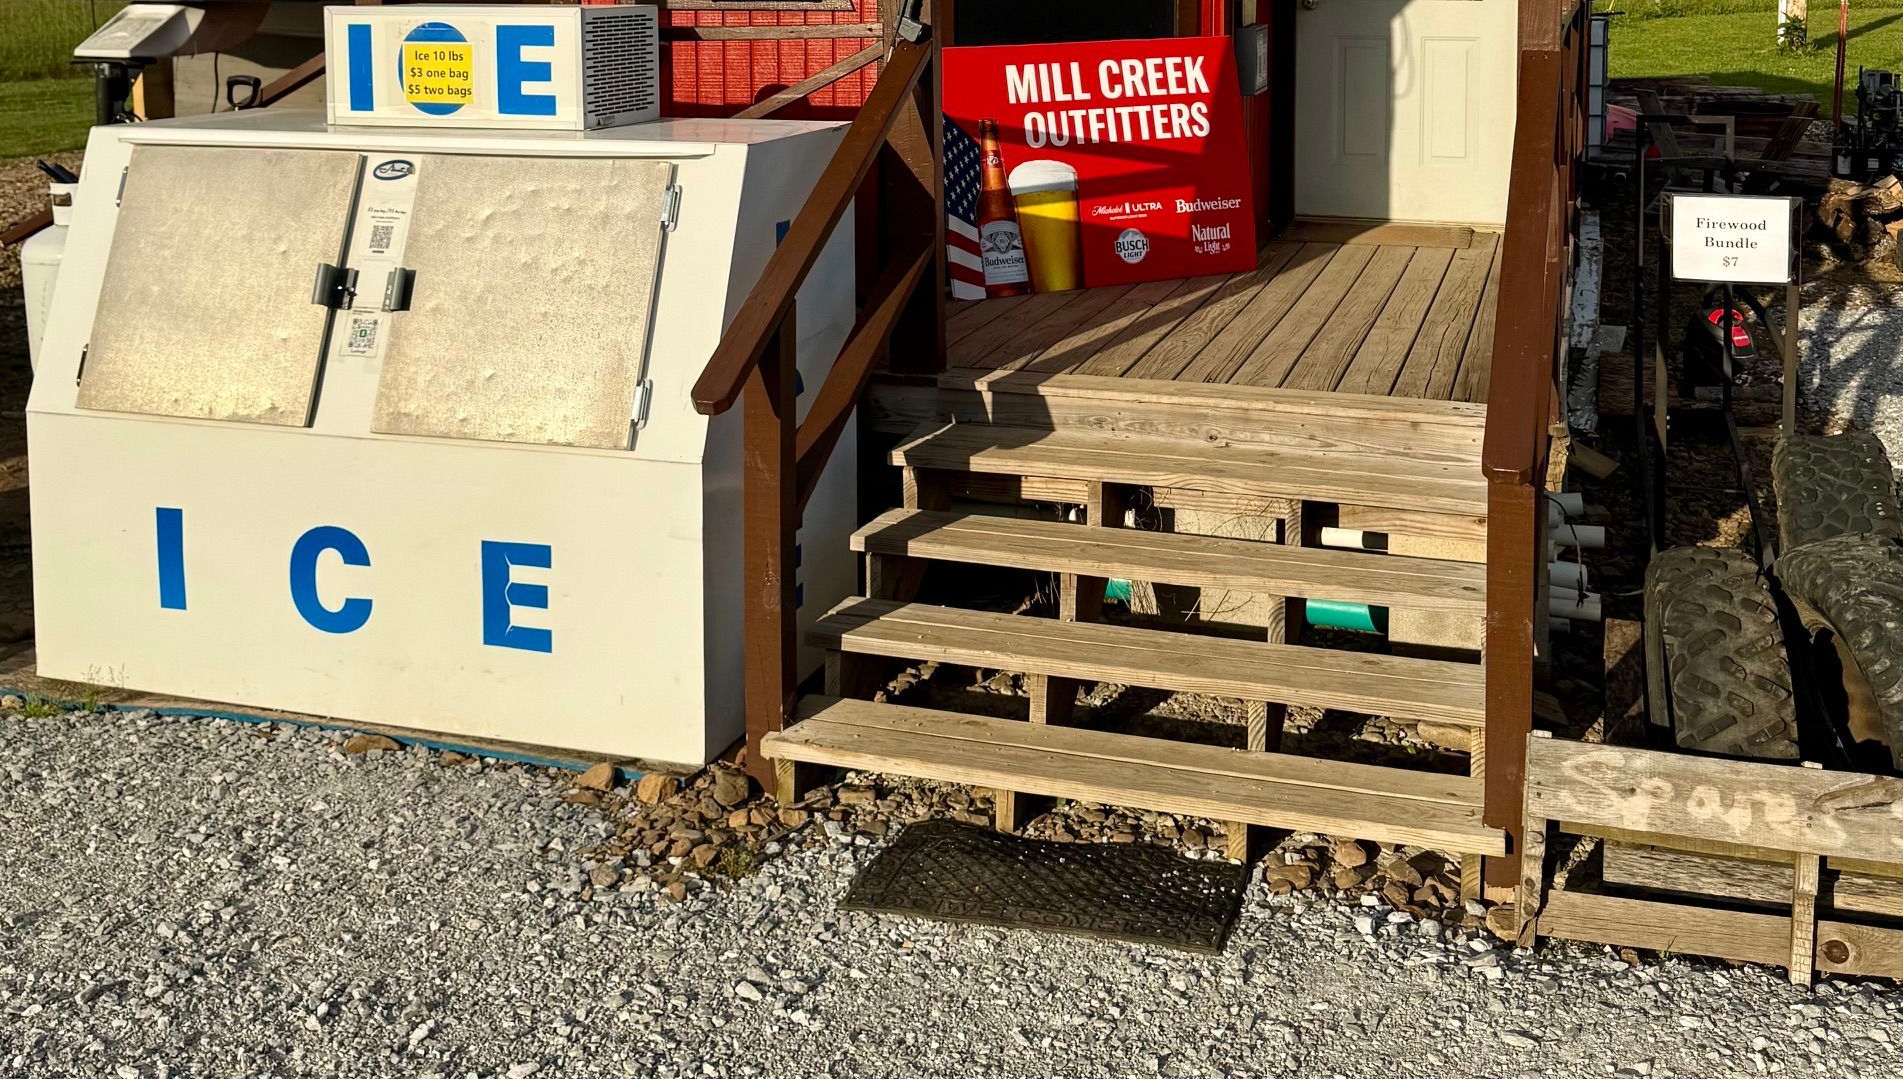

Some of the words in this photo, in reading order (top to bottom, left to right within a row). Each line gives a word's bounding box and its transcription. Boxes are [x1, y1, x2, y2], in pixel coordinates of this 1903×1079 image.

[415, 50, 430, 61] Ice
[433, 50, 446, 61] 10
[448, 50, 464, 61] lbs
[410, 67, 423, 78] $3
[426, 70, 446, 78] one
[449, 67, 469, 81] bag
[1005, 61, 1092, 104] MILL
[1098, 55, 1210, 99] CREEK
[408, 83, 421, 94] $5
[424, 85, 444, 95] two
[447, 84, 472, 98] bags
[1024, 101, 1211, 149] OUTFITTERS
[1131, 201, 1163, 212] ULTRA
[1175, 196, 1242, 214] Budweiser
[1696, 217, 1767, 231] Firewood
[1191, 222, 1231, 242] Natural
[1115, 238, 1149, 253] BUSCH
[1204, 241, 1221, 254] Light
[1704, 236, 1758, 249] Bundle
[984, 255, 1024, 267] Budweiser
[1722, 255, 1739, 268] $7
